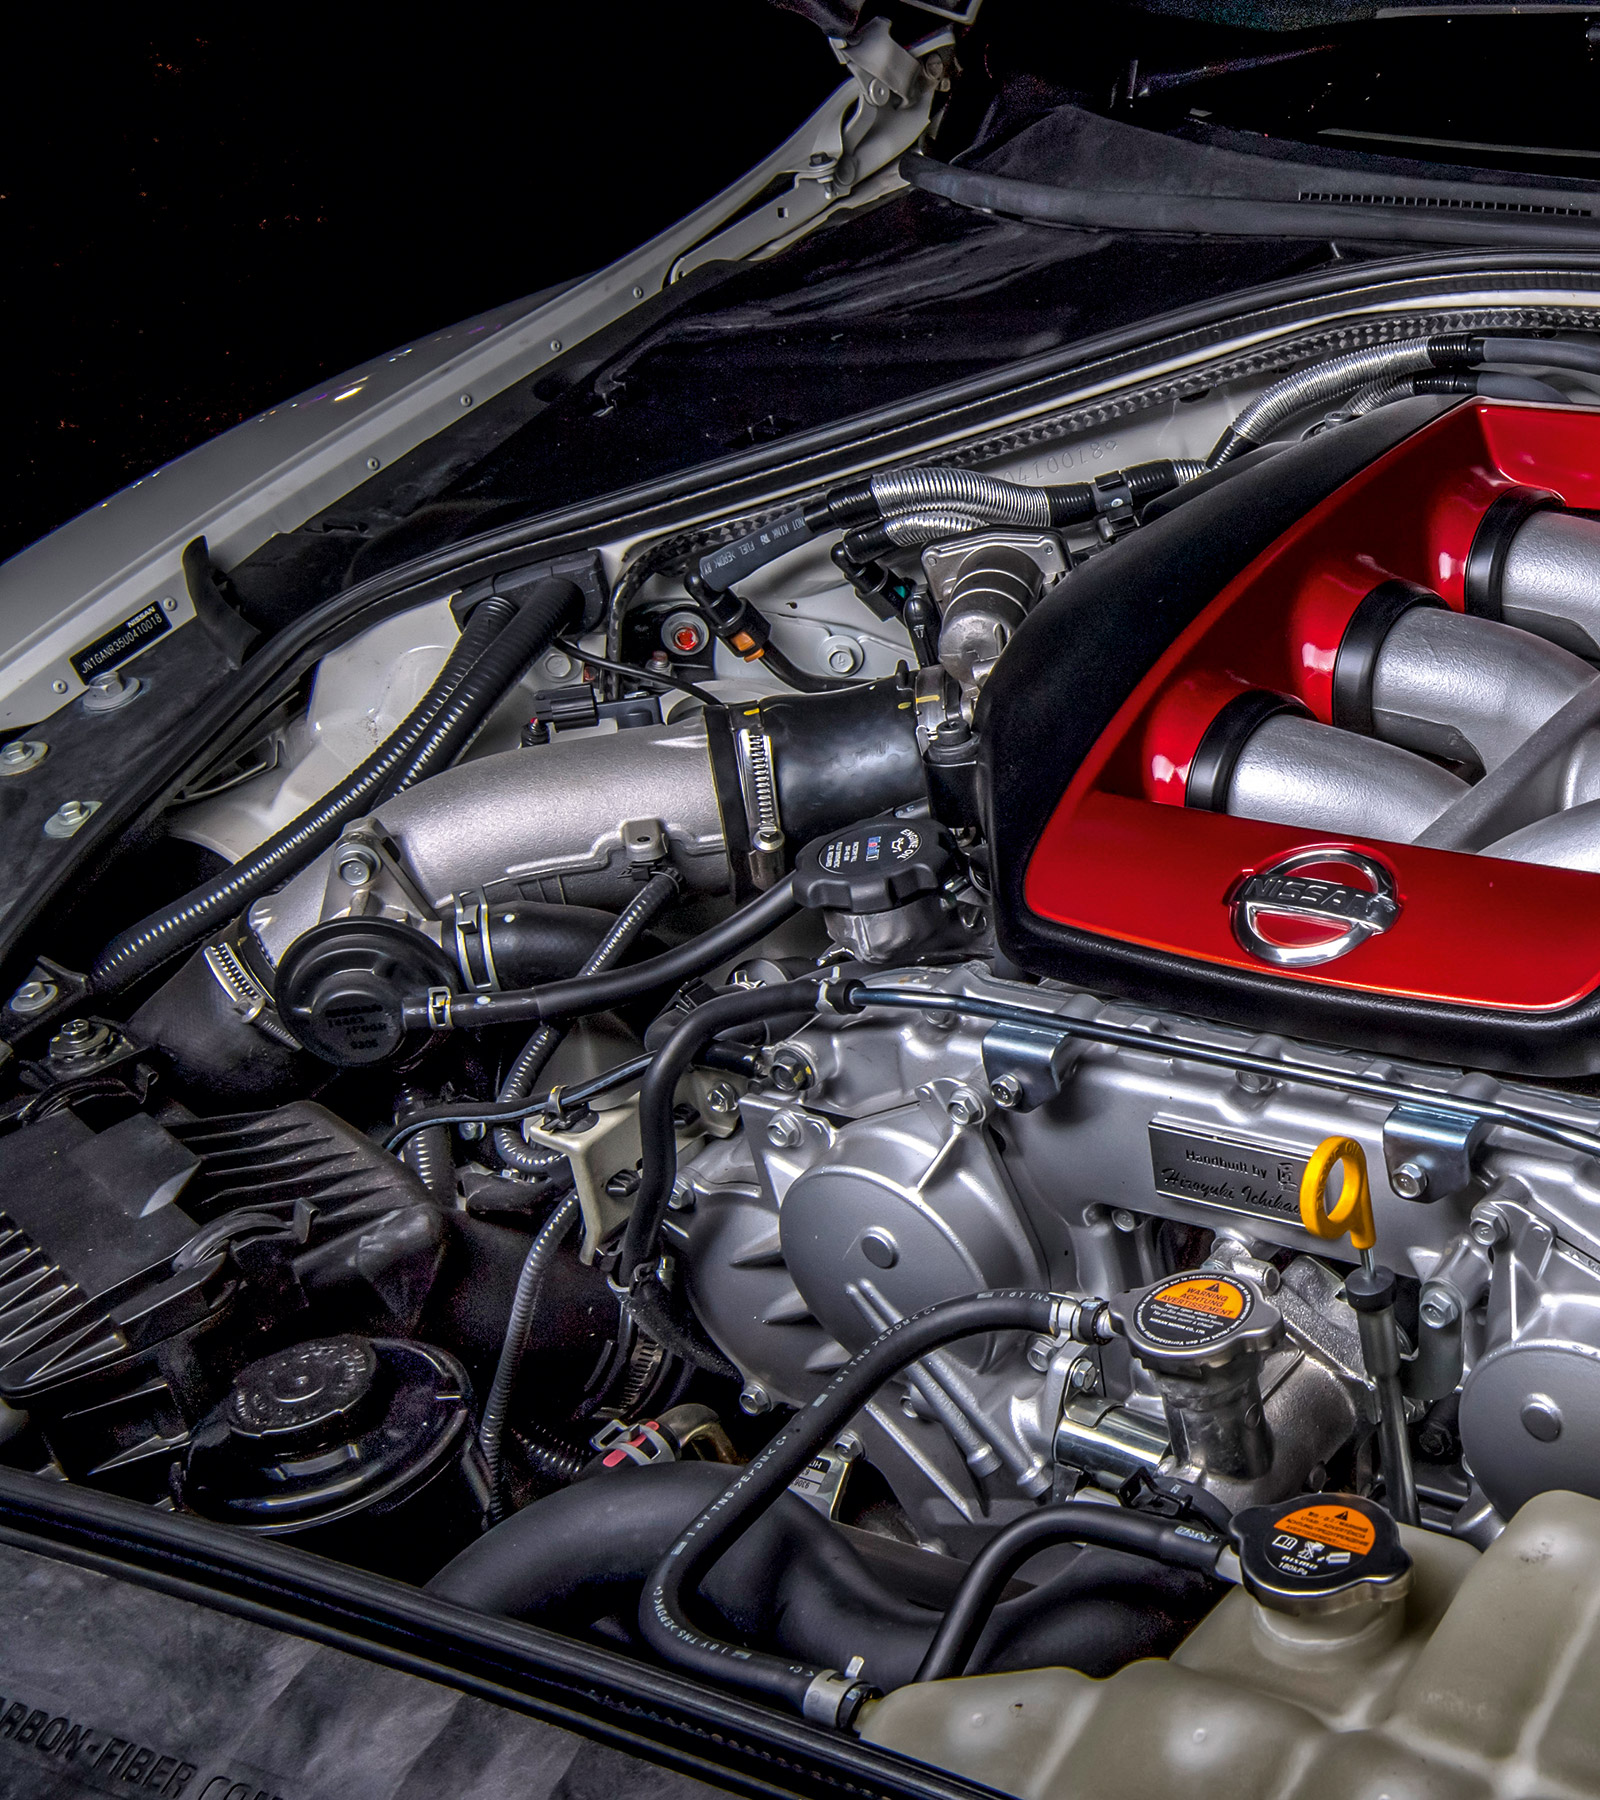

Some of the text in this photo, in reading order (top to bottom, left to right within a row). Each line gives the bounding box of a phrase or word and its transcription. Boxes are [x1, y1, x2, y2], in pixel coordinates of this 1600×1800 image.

[738, 541, 756, 555] FUEL
[127, 606, 156, 628] NISSAN
[896, 828, 919, 859] ENGINE OIL
[1185, 1149, 1268, 1180] Handbuilt by
[1161, 1167, 1301, 1216] Hiroyuki Ichika
[1180, 1293, 1225, 1308] ACHTUNG
[1187, 1287, 1229, 1302] WARNING
[1161, 1295, 1234, 1316] AVERTISSEMENT
[1167, 1322, 1186, 1330] MOTOR
[711, 1492, 734, 1511] TNS
